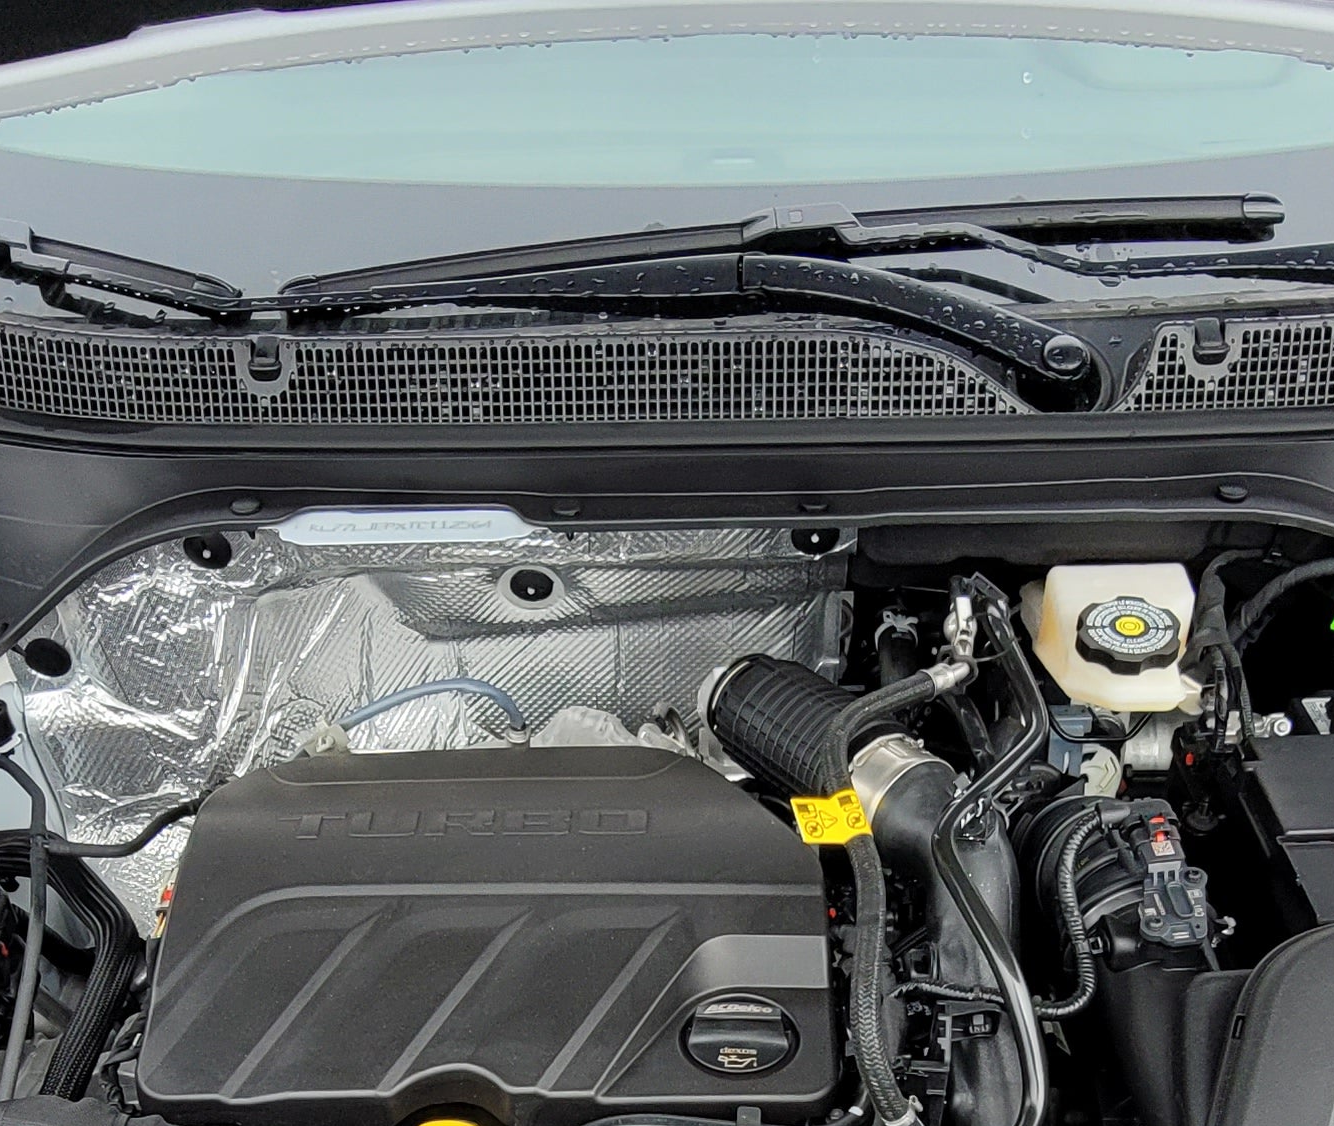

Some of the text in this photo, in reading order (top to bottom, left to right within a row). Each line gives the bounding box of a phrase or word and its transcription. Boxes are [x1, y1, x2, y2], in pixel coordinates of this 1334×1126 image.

[278, 808, 650, 840] TURBO
[703, 1003, 774, 1014] ACDelco
[719, 1047, 758, 1055] dexos
